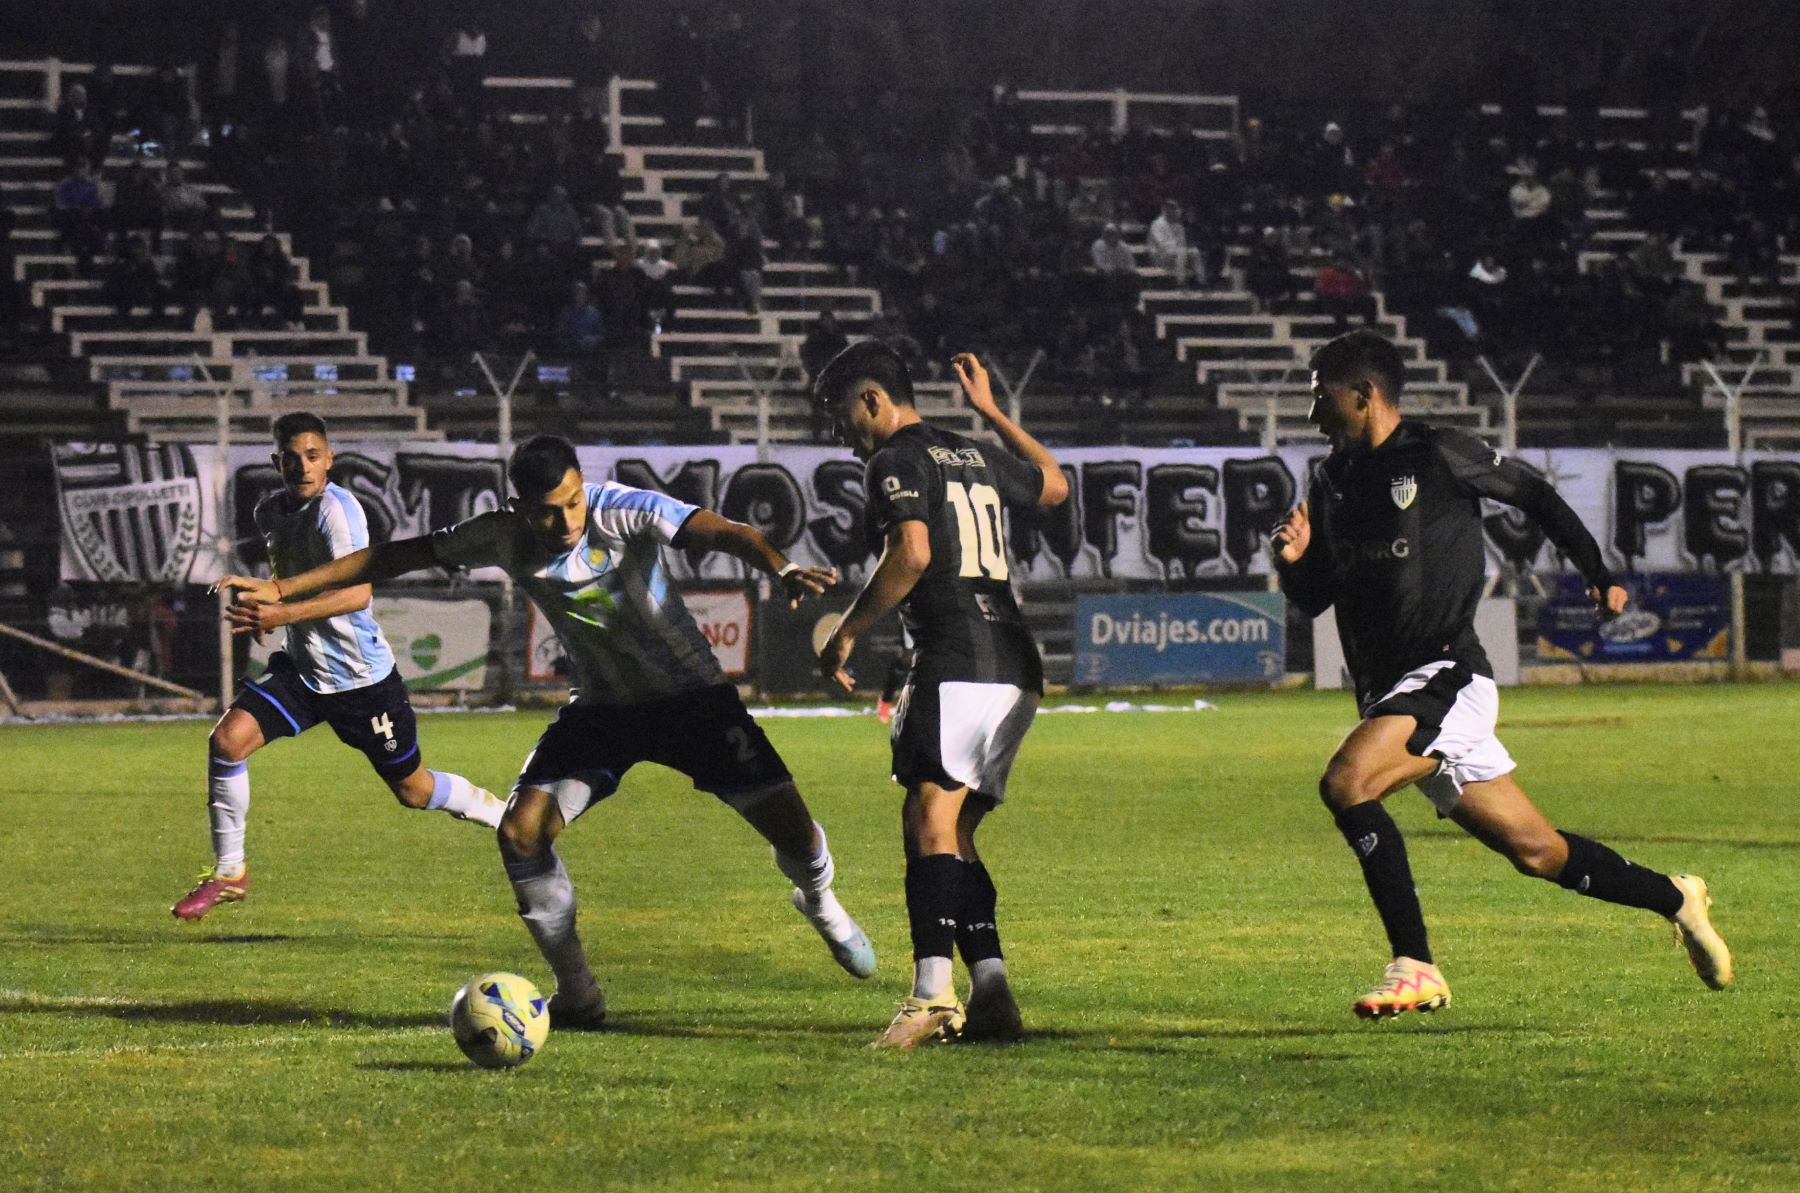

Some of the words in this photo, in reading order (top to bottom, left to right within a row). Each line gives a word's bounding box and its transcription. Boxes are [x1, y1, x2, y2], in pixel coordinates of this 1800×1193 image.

[234, 451, 872, 580] STMOS
[946, 481, 1008, 580] 10
[1091, 612, 1269, 652] Dviajes.com
[371, 712, 394, 740] 4
